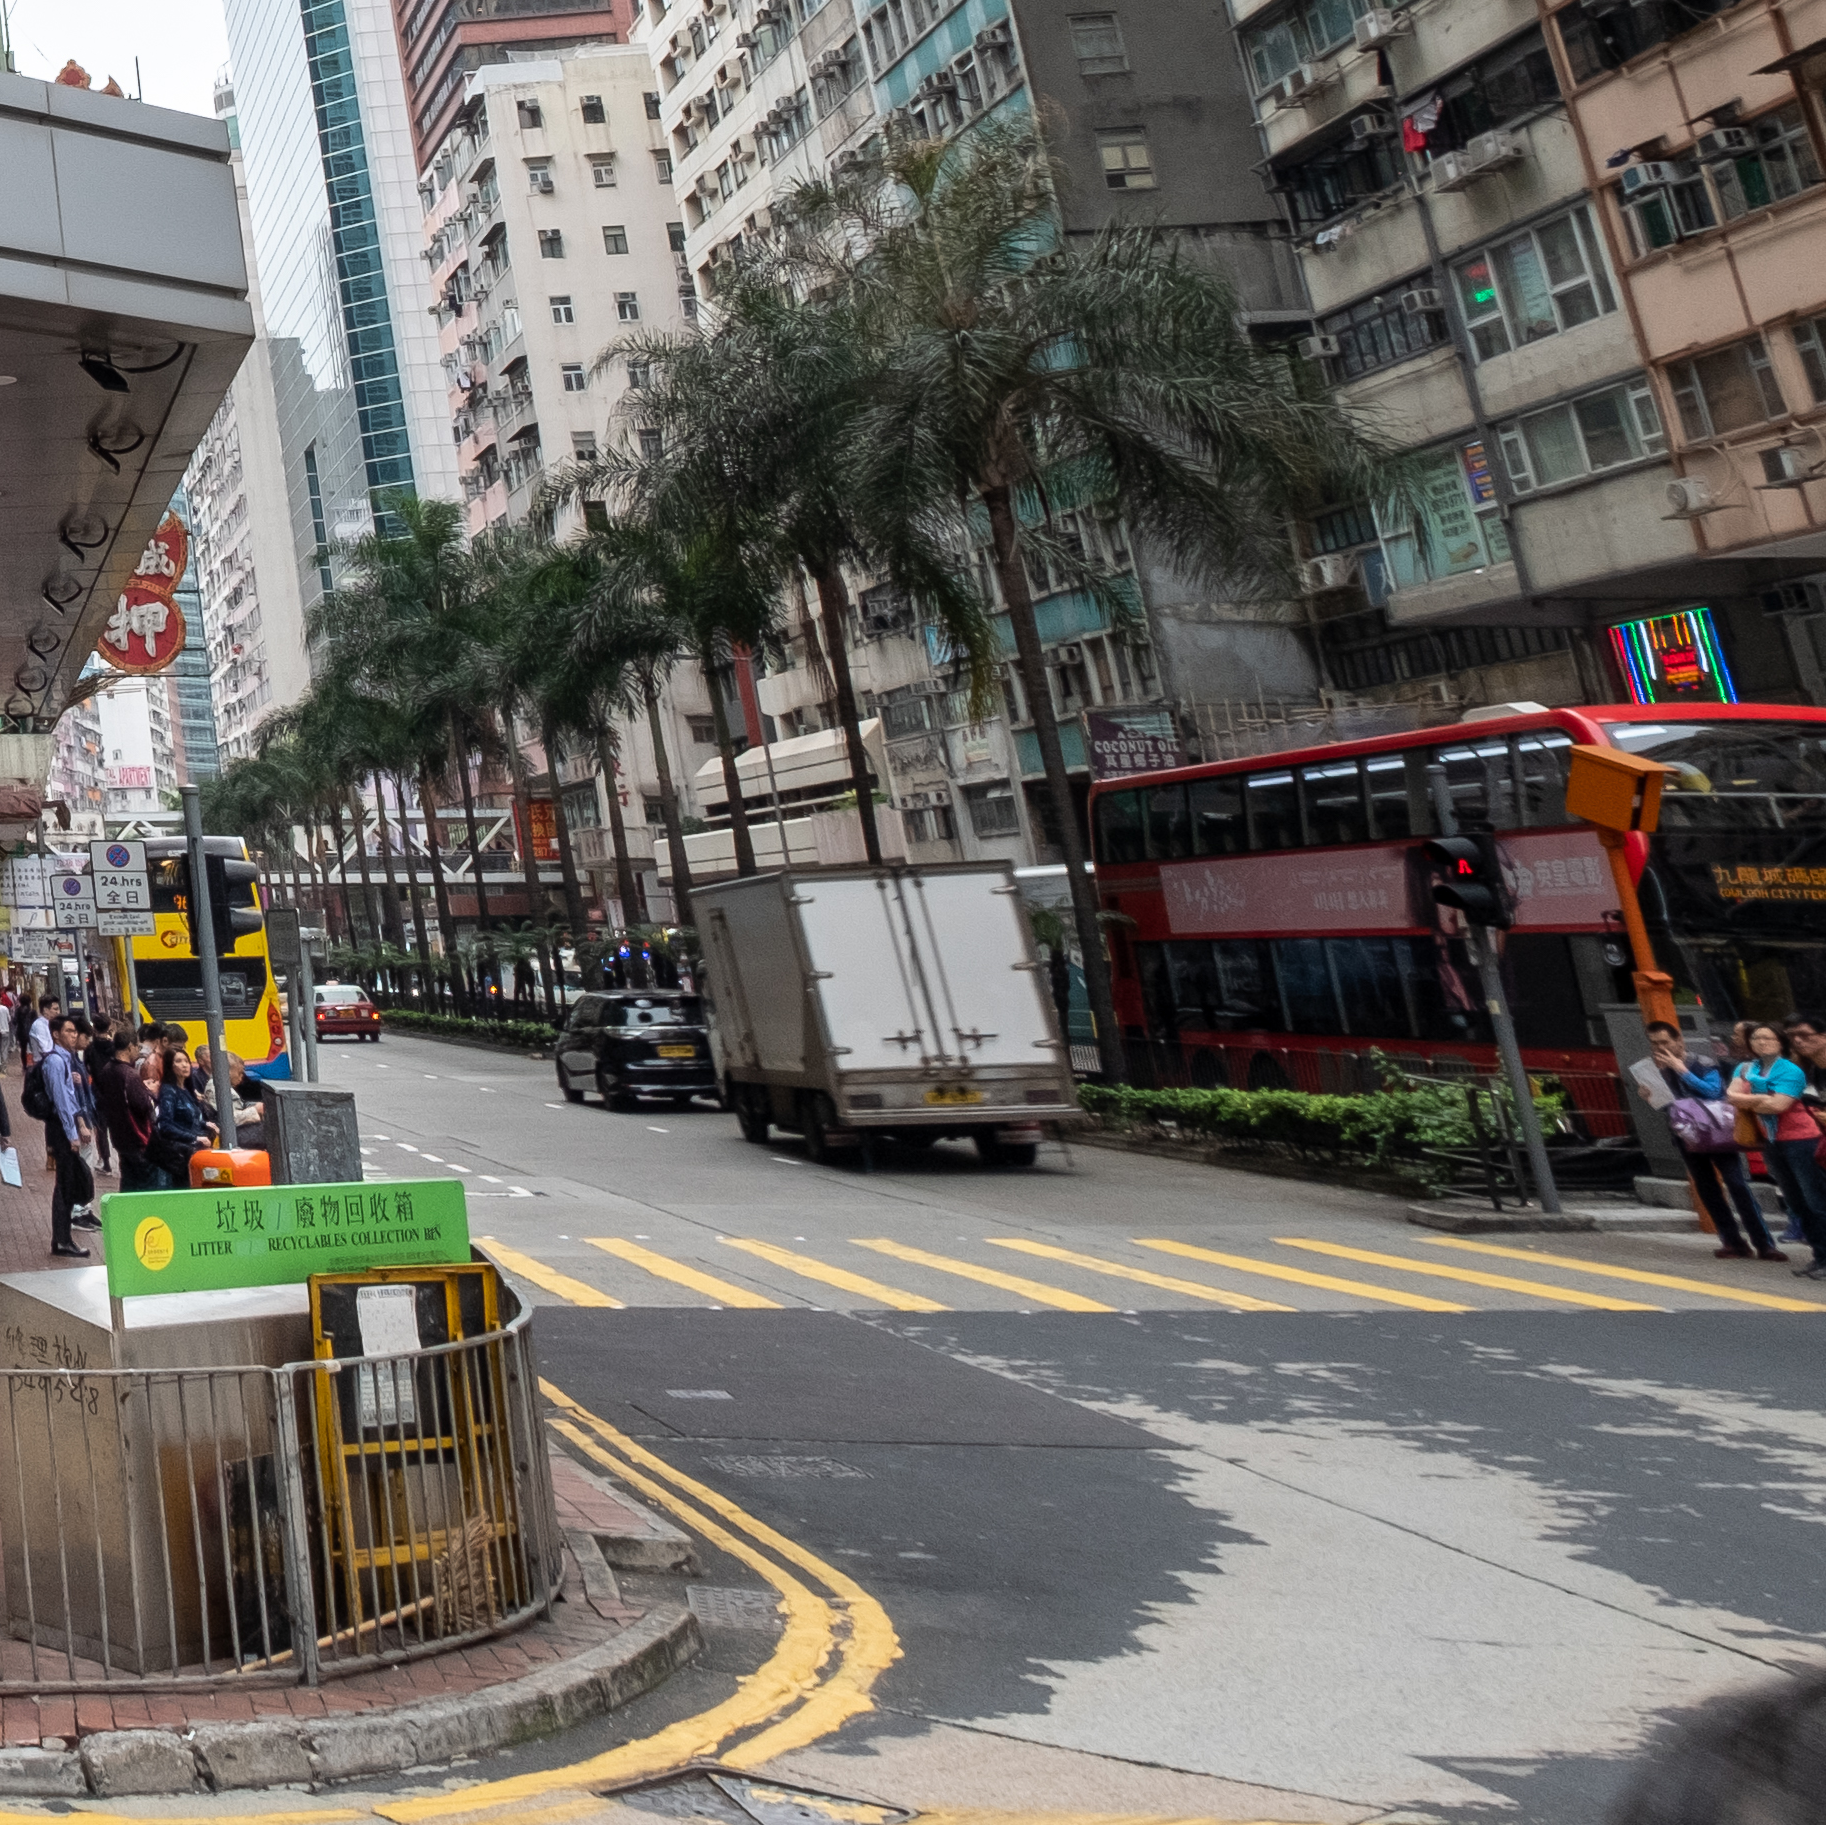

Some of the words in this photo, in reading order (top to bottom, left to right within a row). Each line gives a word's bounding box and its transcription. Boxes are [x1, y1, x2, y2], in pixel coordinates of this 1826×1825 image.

[1094, 739, 1153, 754] COCONUT
[1157, 738, 1180, 753] OIL
[106, 890, 139, 905] 全日
[1770, 888, 1802, 900] CITY
[64, 913, 89, 925] 全日
[215, 1198, 265, 1234] 垃圾
[294, 1189, 416, 1230] 廢物回收箱
[190, 1240, 234, 1258] LITTER
[267, 1232, 348, 1253] RECYCLABLES
[350, 1228, 420, 1247] COLLECTION
